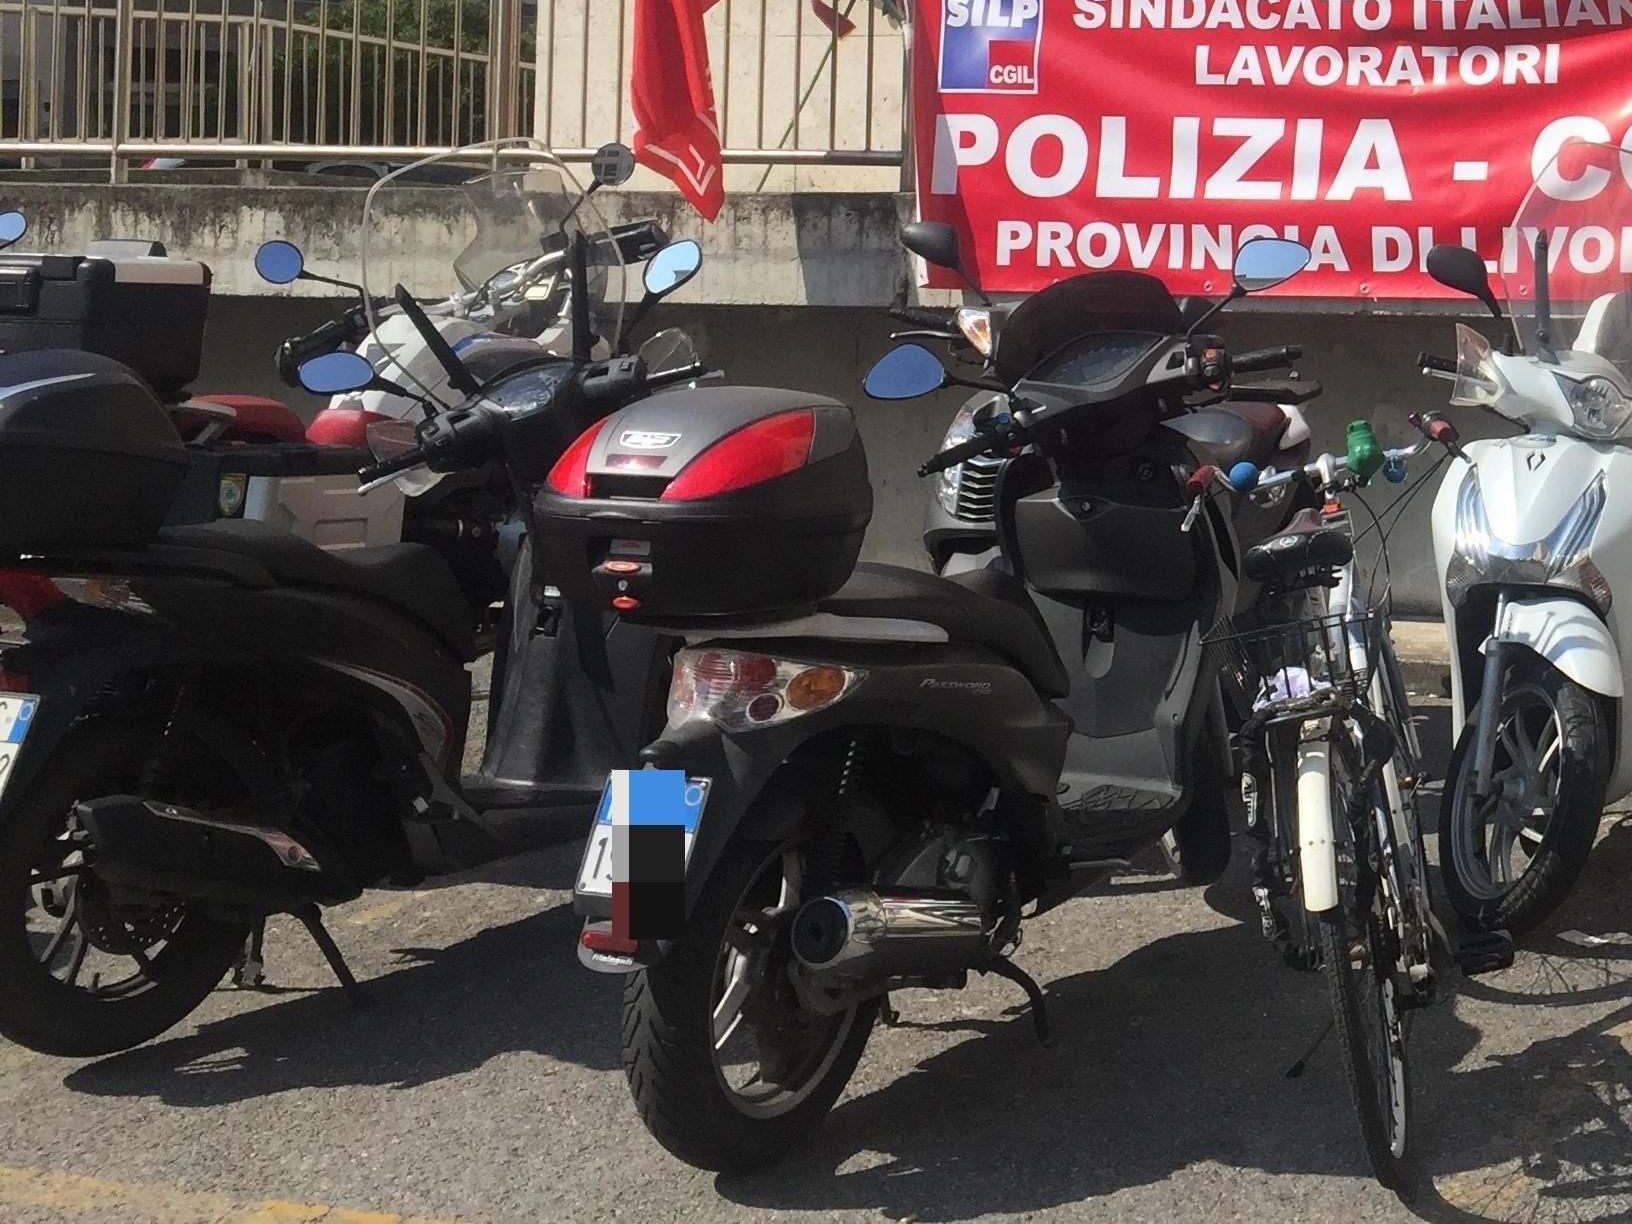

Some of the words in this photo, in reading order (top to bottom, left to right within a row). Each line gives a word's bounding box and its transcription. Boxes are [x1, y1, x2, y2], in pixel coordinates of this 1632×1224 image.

[989, 64, 1034, 85] CGIL
[1195, 43, 1560, 87] LAVORATORI
[931, 113, 1411, 201] POLIZIA
[996, 220, 1349, 273] PROVINA
